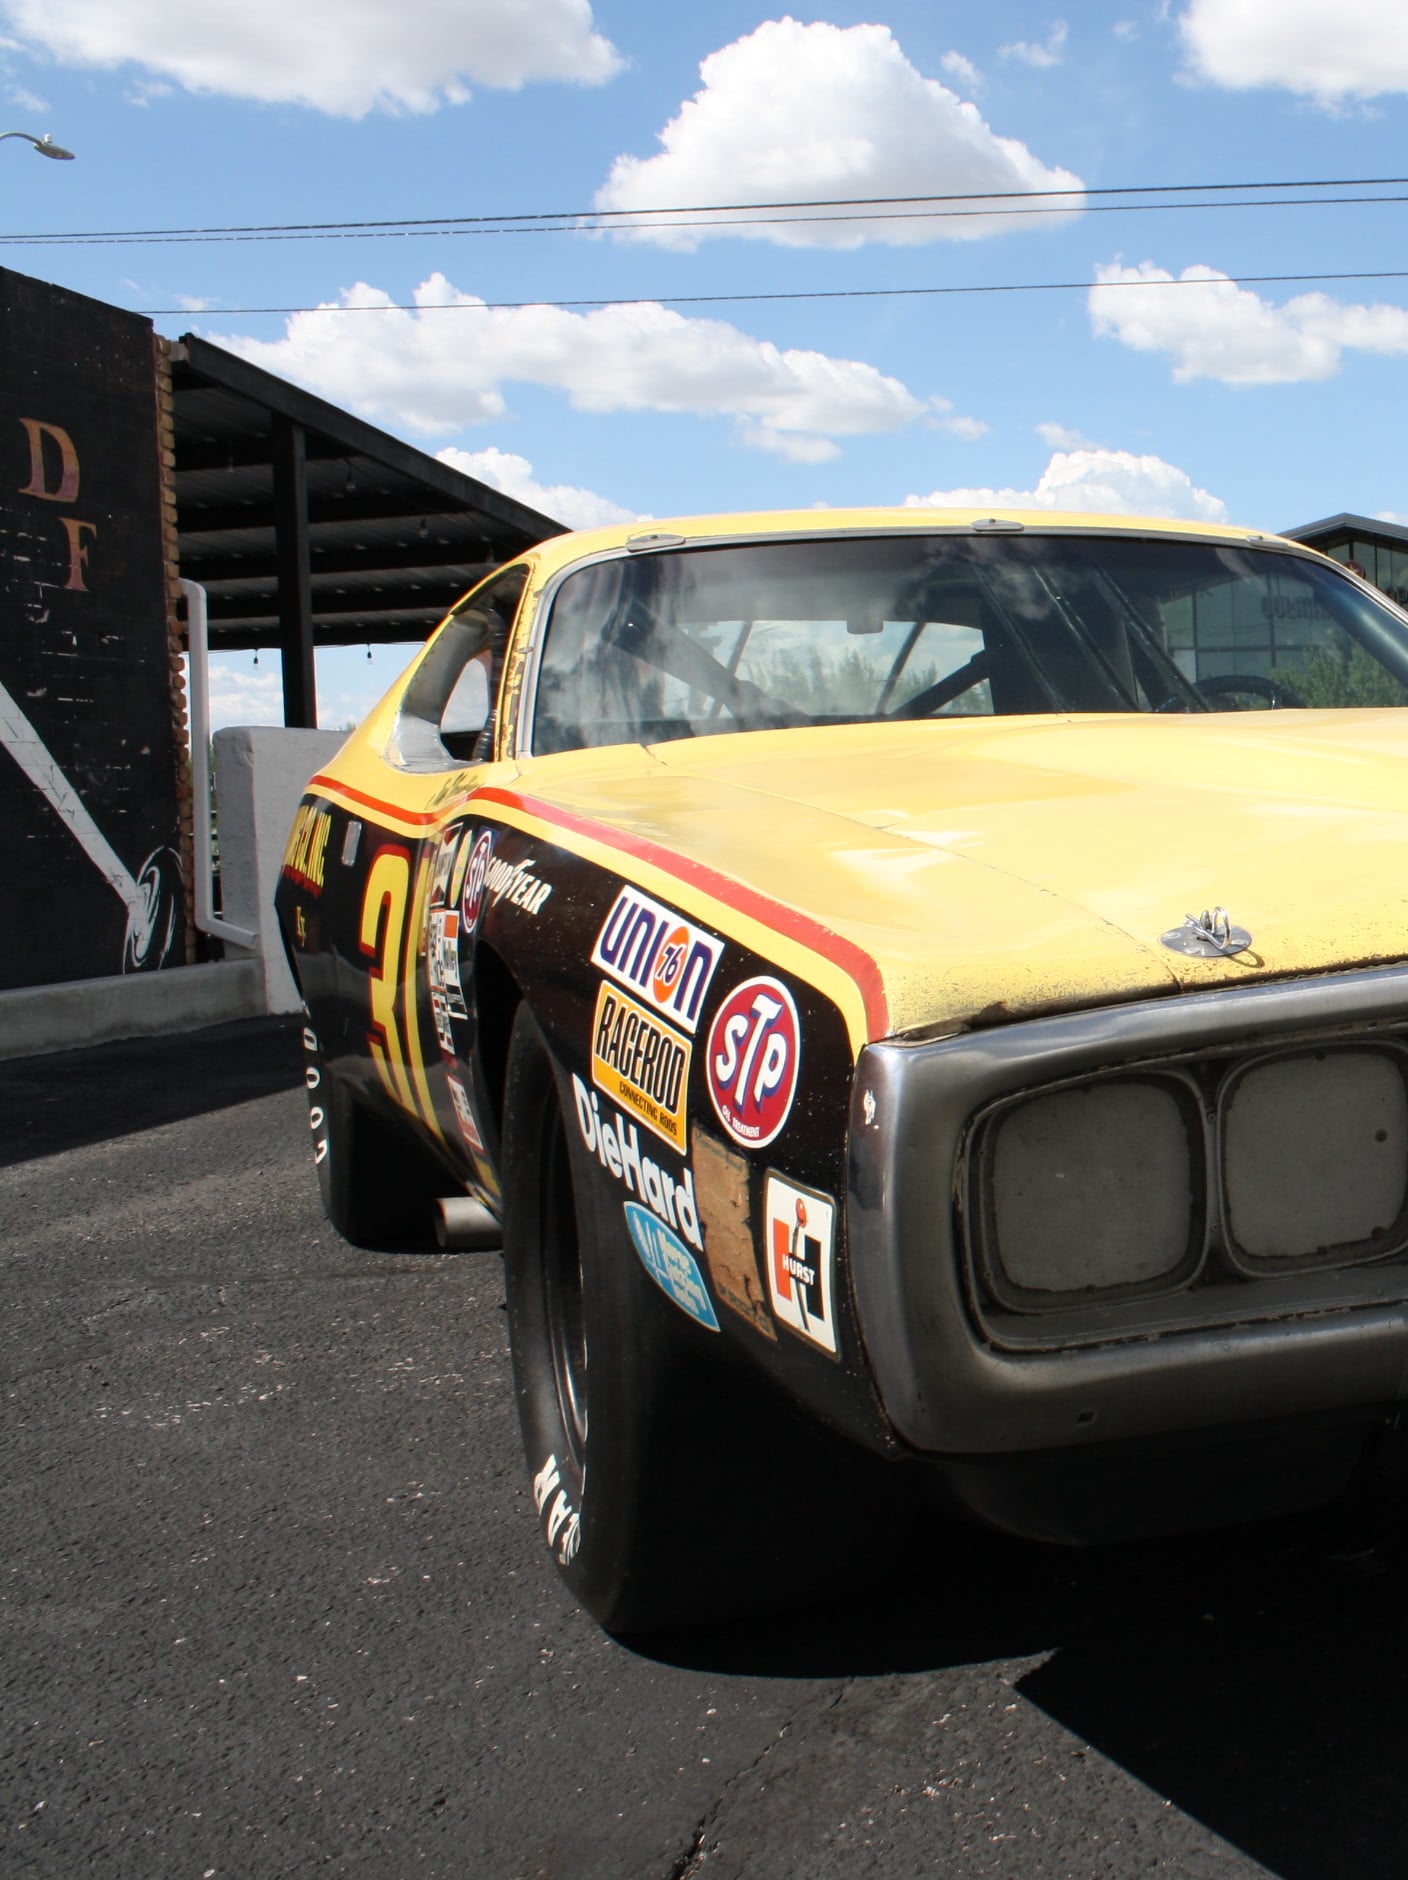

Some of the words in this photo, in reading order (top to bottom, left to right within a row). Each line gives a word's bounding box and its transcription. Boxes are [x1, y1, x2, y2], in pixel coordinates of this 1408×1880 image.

[18, 417, 81, 503] D
[59, 516, 98, 592] F
[483, 856, 553, 915] GOODYEAR
[600, 896, 713, 1022] UNION
[660, 942, 686, 985] 76
[595, 996, 686, 1115] RACEROD
[715, 993, 787, 1115] STP
[619, 1081, 658, 1122] CONNECTING
[659, 1108, 678, 1136] RODS
[731, 1116, 760, 1138] TREATMENT
[572, 1073, 704, 1252] DieHard
[782, 1253, 816, 1286] HURST
